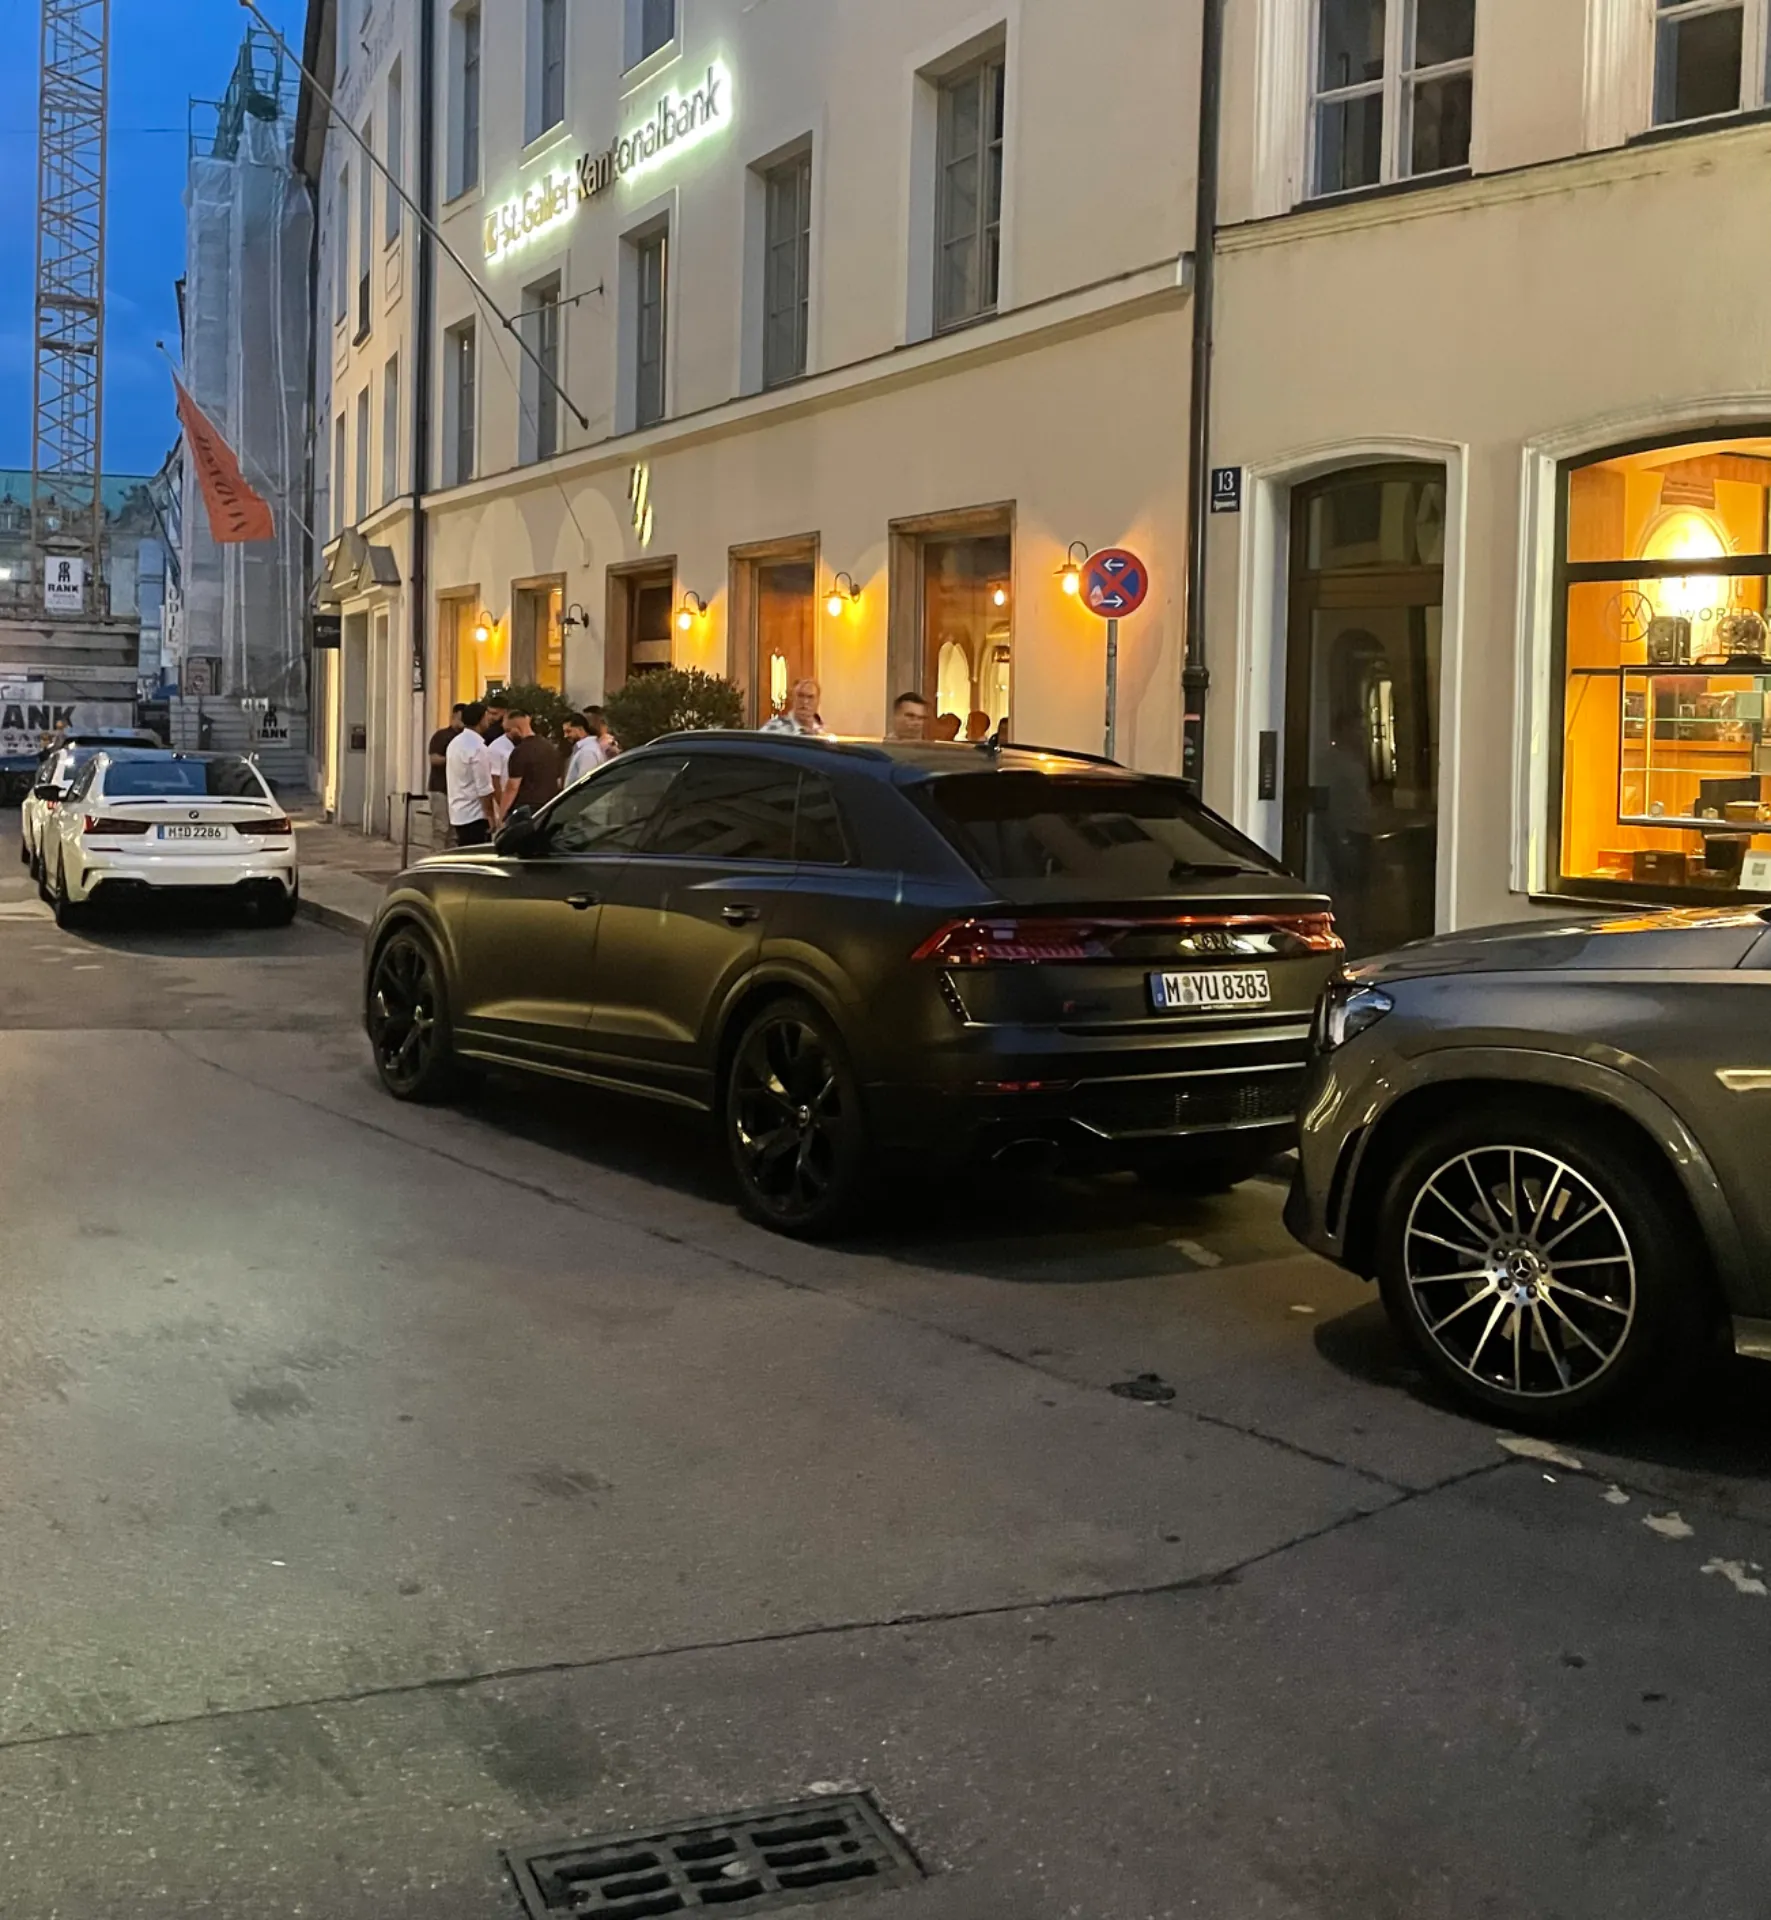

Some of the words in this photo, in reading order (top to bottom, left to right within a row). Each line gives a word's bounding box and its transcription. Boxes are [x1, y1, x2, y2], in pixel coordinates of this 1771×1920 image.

[575, 66, 721, 201] Kantonalbank
[1218, 470, 1234, 492] 13
[193, 827, 221, 837] 2286
[1165, 976, 1181, 1004] M
[1192, 974, 1220, 1001] YU
[1223, 973, 1268, 998] 8383
